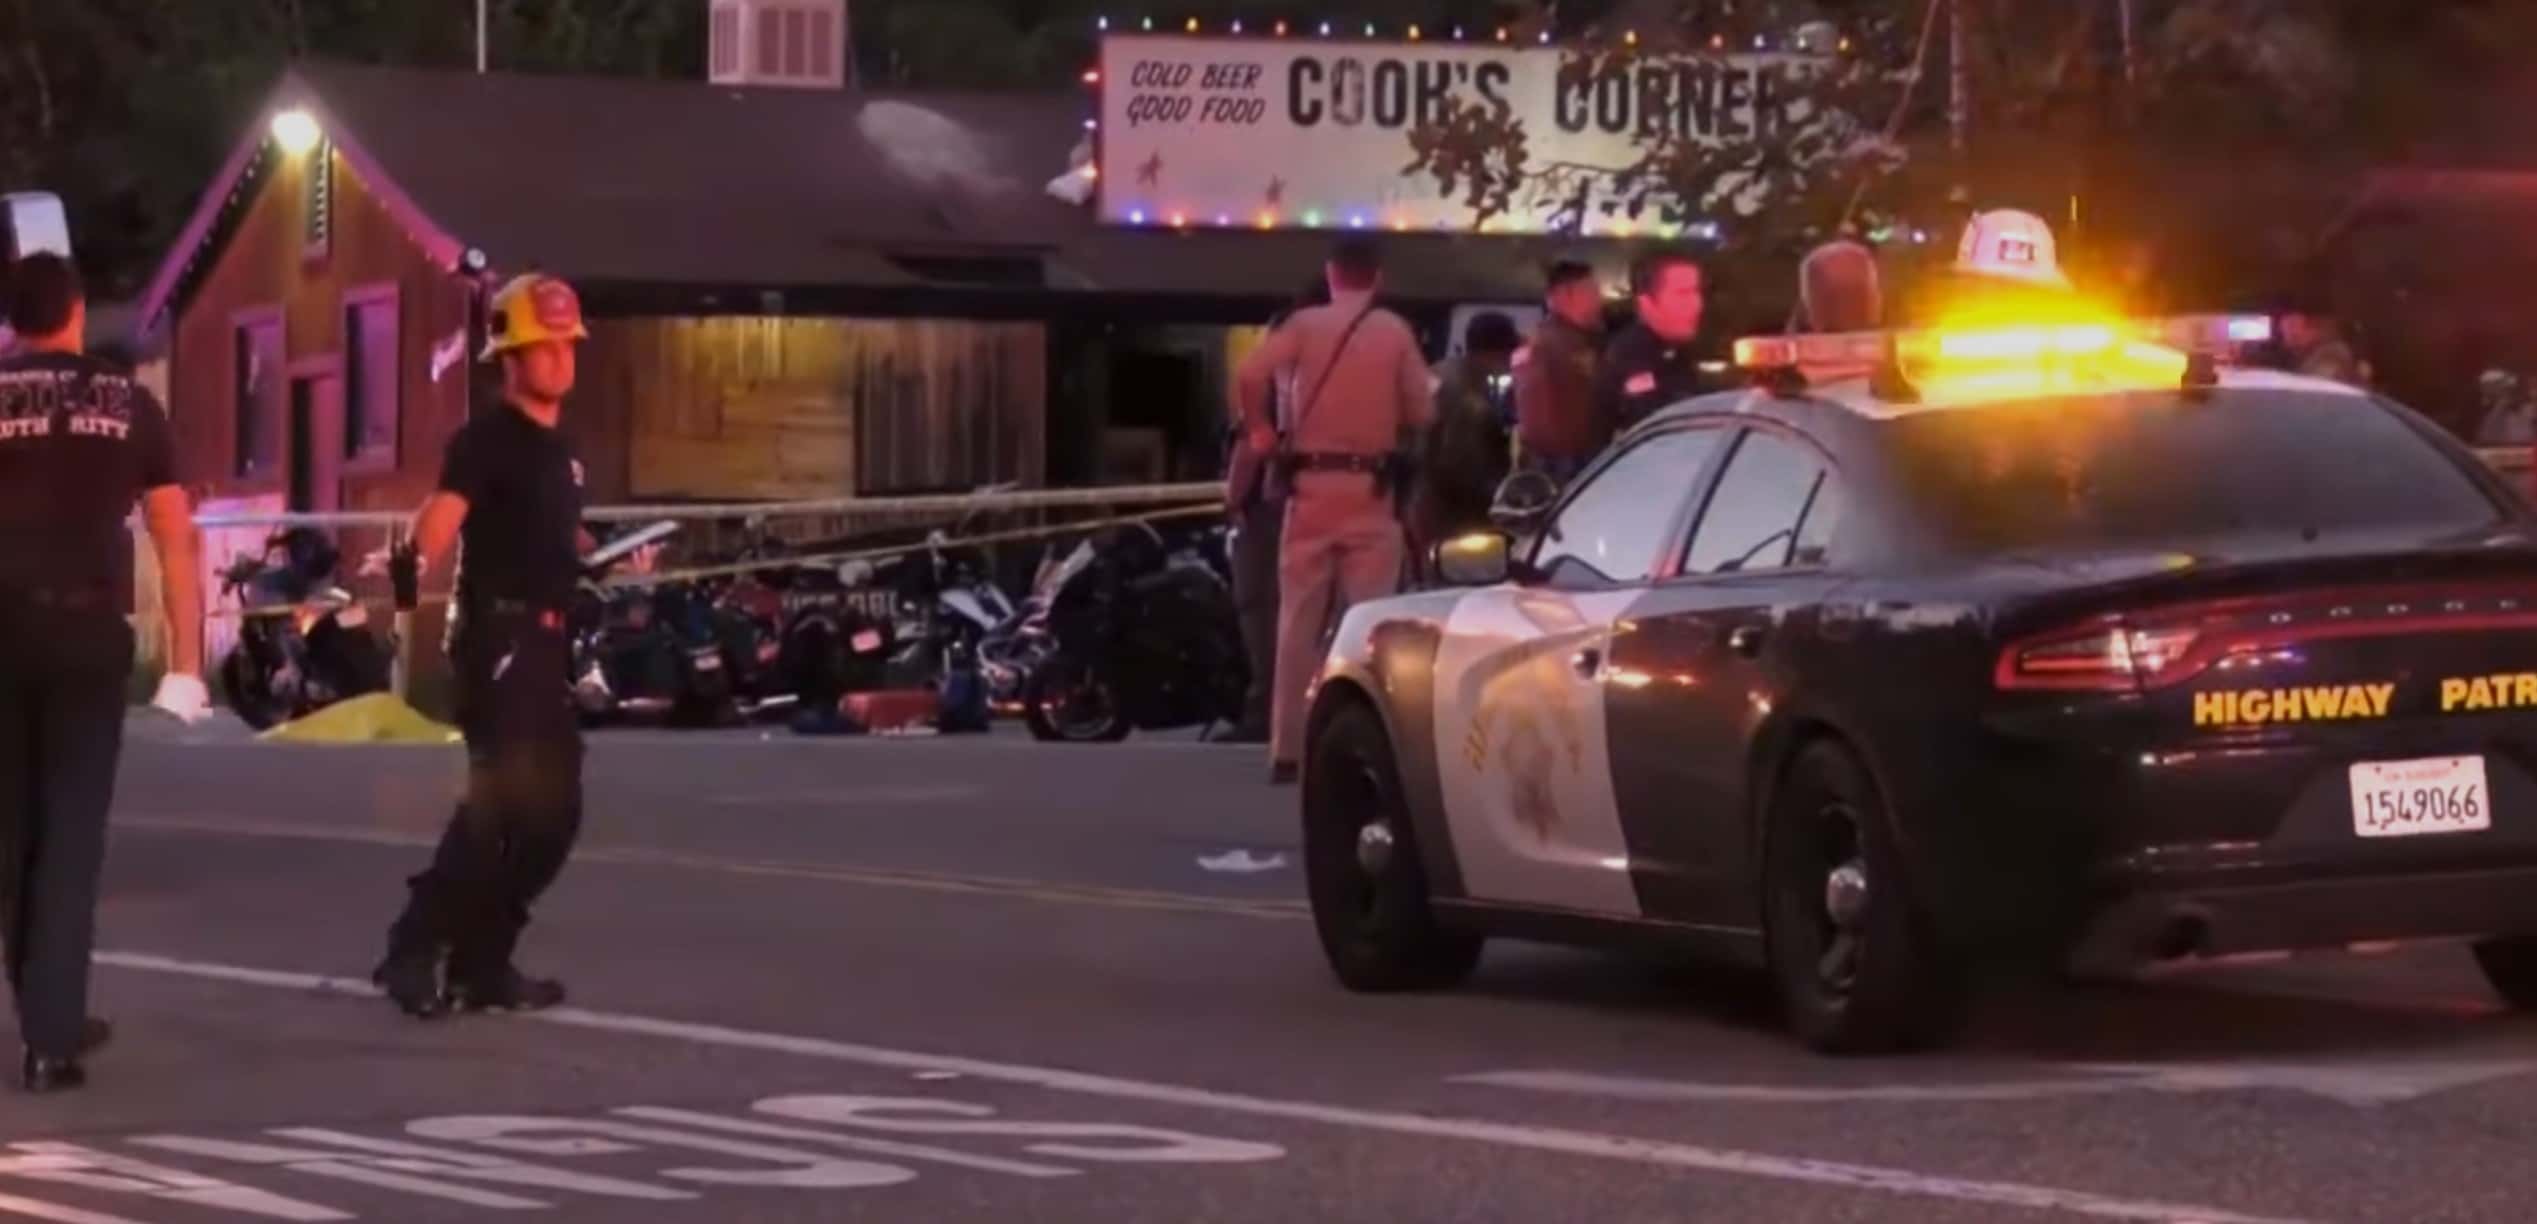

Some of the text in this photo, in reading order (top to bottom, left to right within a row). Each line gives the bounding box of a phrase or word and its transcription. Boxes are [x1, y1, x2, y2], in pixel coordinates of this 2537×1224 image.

[1131, 60, 1263, 89] COLD BEER
[1288, 56, 1511, 128] COOK'S
[1127, 95, 1266, 127] GOOD FOOD
[2194, 672, 2537, 725] HIGHWAY PATR
[2365, 784, 2479, 825] 1549066
